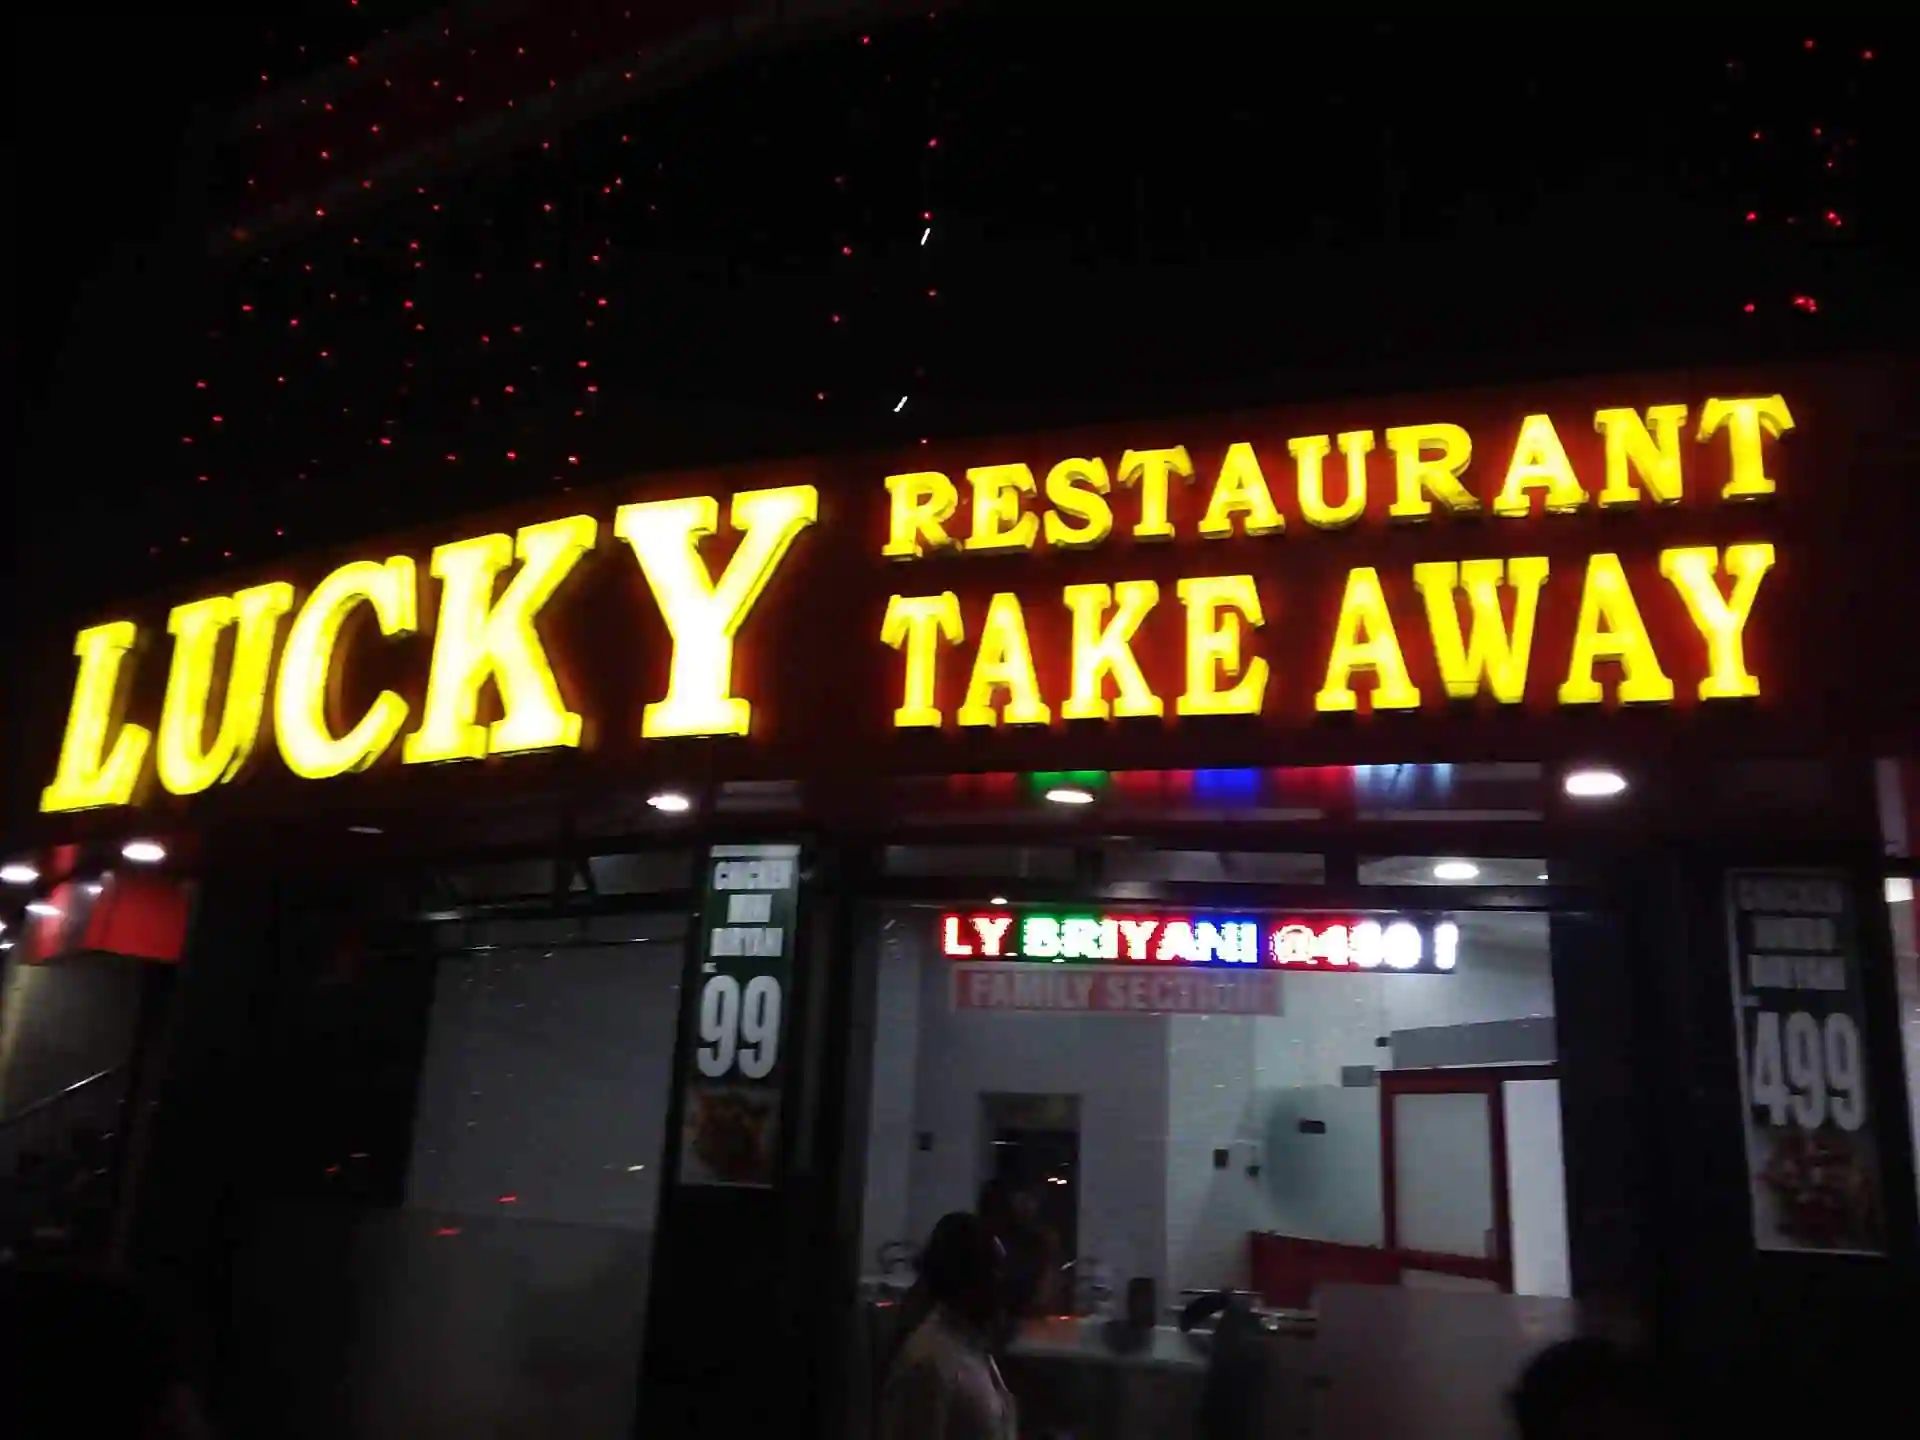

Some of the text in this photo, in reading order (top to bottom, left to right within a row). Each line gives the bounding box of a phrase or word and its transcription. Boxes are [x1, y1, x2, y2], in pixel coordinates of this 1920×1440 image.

[881, 394, 1795, 561] RESTAURANT
[40, 484, 818, 812] LUCKY
[880, 544, 1776, 729] TAKE AWAY
[944, 917, 1012, 956] LY
[1023, 916, 1258, 963] BRIYANI
[969, 970, 1095, 1009] FAMILY
[697, 974, 782, 1079] 99
[1752, 1011, 1866, 1132] 499
